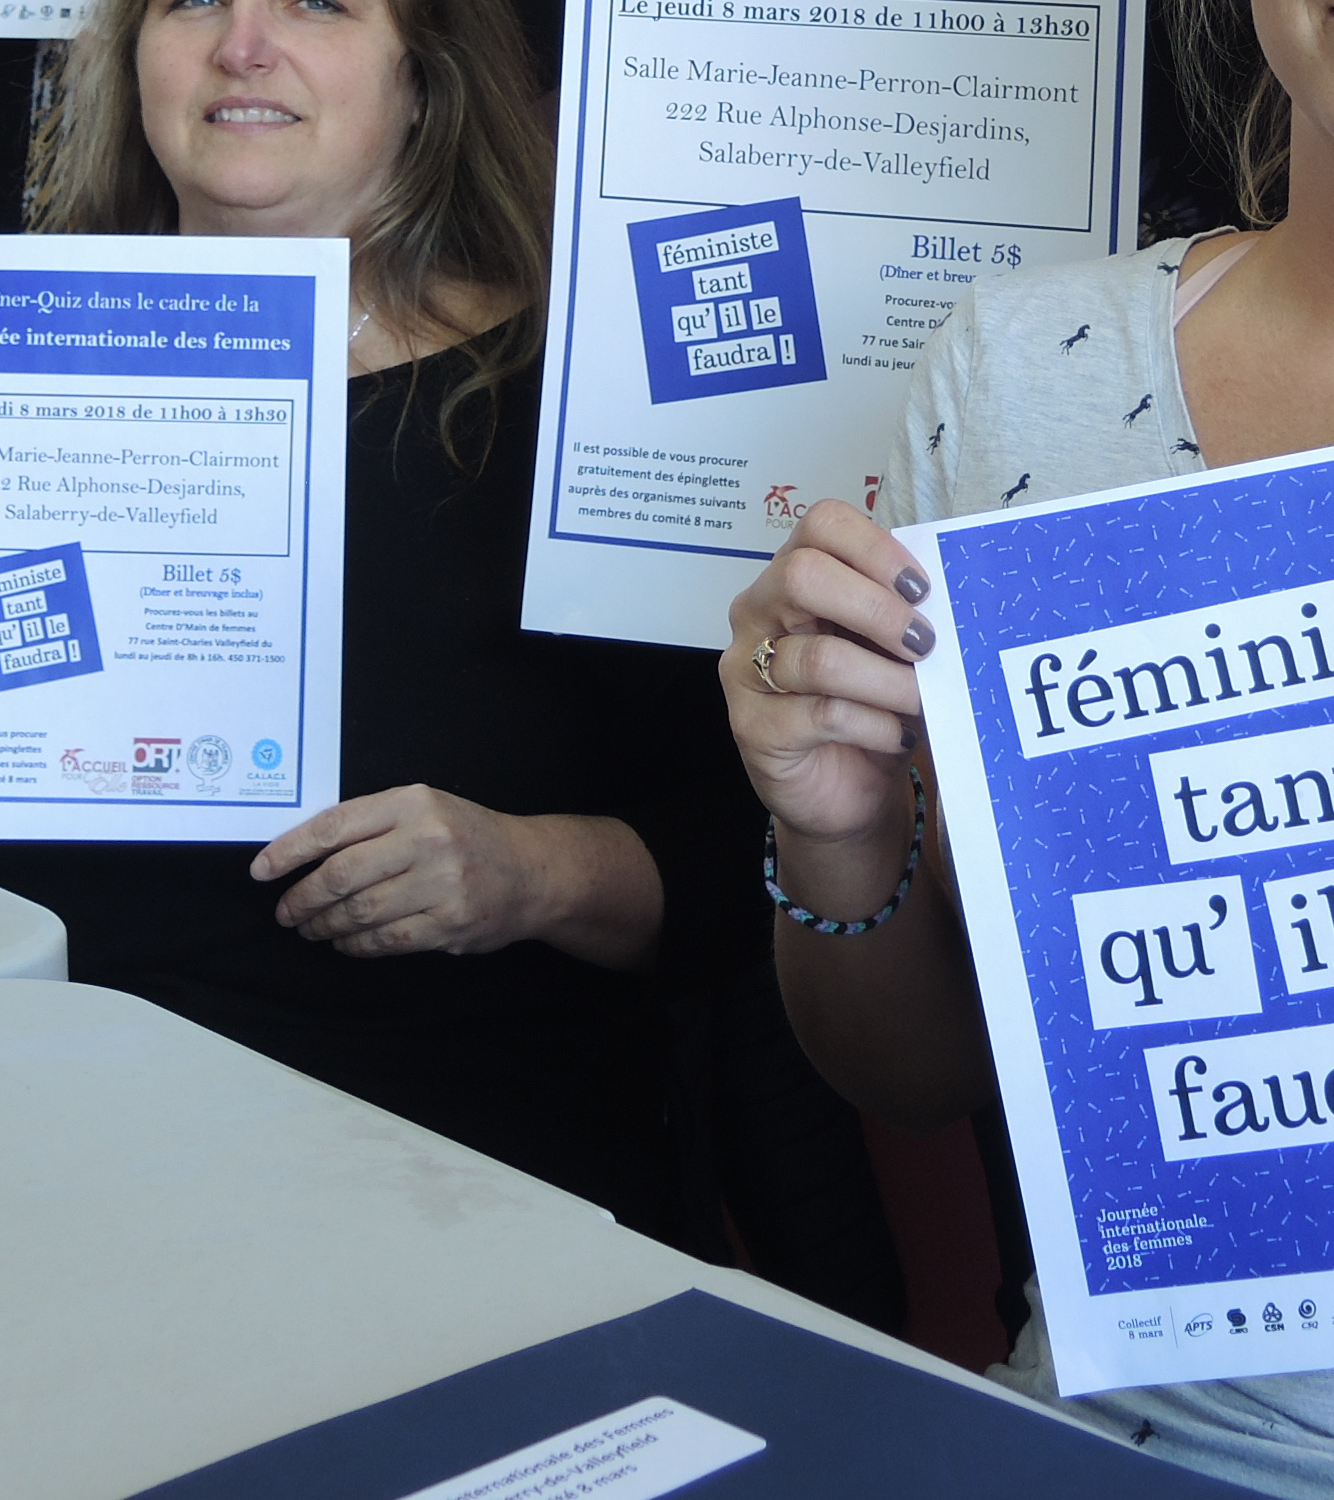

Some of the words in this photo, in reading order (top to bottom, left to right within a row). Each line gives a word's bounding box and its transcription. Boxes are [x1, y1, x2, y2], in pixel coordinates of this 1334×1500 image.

[722, 0, 735, 19] 8
[743, 5, 801, 22] mars
[809, 6, 866, 26] 2018
[875, 7, 903, 28] de
[913, 9, 984, 32] 11h00
[993, 13, 1006, 34] à
[1016, 15, 1090, 38] 13h30
[623, 56, 679, 81] Salle
[686, 61, 1079, 104] Marie-Jeanne-Perron-Clairmont
[666, 102, 708, 123] 222
[717, 103, 762, 125] Rue
[770, 106, 1030, 145] Alphonse-Desjardins,
[699, 141, 990, 182] Salaberry-de-Valleyfield
[663, 233, 773, 266] féministe
[911, 235, 982, 262] Billet
[991, 244, 1021, 269] 5$
[698, 271, 747, 295] tant
[880, 265, 922, 281] (Dîner
[927, 270, 939, 281] et
[944, 269, 976, 283] breu
[87, 292, 132, 310] dans
[138, 294, 154, 311] le
[159, 294, 210, 312] cadre
[215, 295, 237, 312] de
[243, 295, 259, 313] la
[885, 295, 956, 309] Procurez-vo
[725, 306, 741, 327] il
[755, 304, 777, 325] le
[886, 316, 925, 328] Centre
[26, 328, 168, 349] internationale
[174, 332, 207, 349] des
[213, 332, 291, 350] femmes
[862, 335, 876, 345] 77
[879, 338, 898, 348] rue
[693, 344, 771, 371] faudra
[785, 340, 790, 359] !
[842, 354, 871, 366] lundi
[875, 359, 888, 368] au
[892, 359, 915, 370] jeu
[19, 403, 29, 417] 8
[36, 406, 78, 418] mars
[84, 405, 126, 420] 2018
[132, 404, 153, 419] de
[160, 405, 213, 421] 11h00
[217, 406, 227, 421] à
[234, 407, 287, 423] 13h30
[573, 442, 580, 452] Il
[583, 444, 600, 454] est
[603, 446, 649, 459] possible
[652, 449, 666, 461] de
[669, 453, 695, 463] vous
[699, 455, 748, 468] procurer
[577, 465, 651, 480] gratuitement
[654, 470, 674, 482] des
[677, 472, 740, 488] épinglettes
[17, 476, 52, 493] Rue
[56, 477, 246, 500] Alphonse-Desjardins,
[568, 485, 606, 497] auprès
[609, 487, 629, 499] des
[632, 491, 696, 505] organismes
[699, 496, 746, 510] suivants
[4, 504, 218, 528] Salaberry-de-Valleyfield
[578, 506, 631, 520] membres
[635, 510, 649, 522] du
[652, 513, 691, 526] comité
[694, 517, 701, 526] 8
[704, 519, 733, 530] mars
[162, 564, 214, 583] Billet
[219, 568, 242, 586] 5$
[174, 588, 183, 597] et
[185, 587, 229, 601] breuvage
[7, 597, 44, 615] tant
[144, 607, 203, 617] Procurez-vous
[206, 608, 217, 617] les
[219, 609, 245, 618] billets
[27, 622, 40, 638] il
[50, 619, 65, 634] le
[145, 622, 173, 631] Centre
[209, 624, 220, 632] de
[221, 624, 256, 633] femmes
[128, 637, 139, 645] 77
[140, 638, 155, 646] rue
[157, 637, 213, 647] Saint-Charles
[215, 639, 259, 649] Valleyfield
[261, 640, 273, 648] du
[4, 648, 63, 670] faudra
[72, 643, 77, 659] !
[114, 651, 136, 660] lundi
[150, 652, 172, 662] jeudi
[174, 653, 185, 661] de
[1099, 1203, 1157, 1222] Journée
[1100, 1214, 1207, 1239] internationale
[1103, 1241, 1129, 1254] des
[1134, 1235, 1192, 1249] femmes
[1106, 1254, 1142, 1270] 2018
[1119, 1316, 1161, 1329] Collectif
[1185, 1321, 1212, 1333] APTS
[1129, 1331, 1135, 1339] 8
[1139, 1330, 1163, 1338] mars
